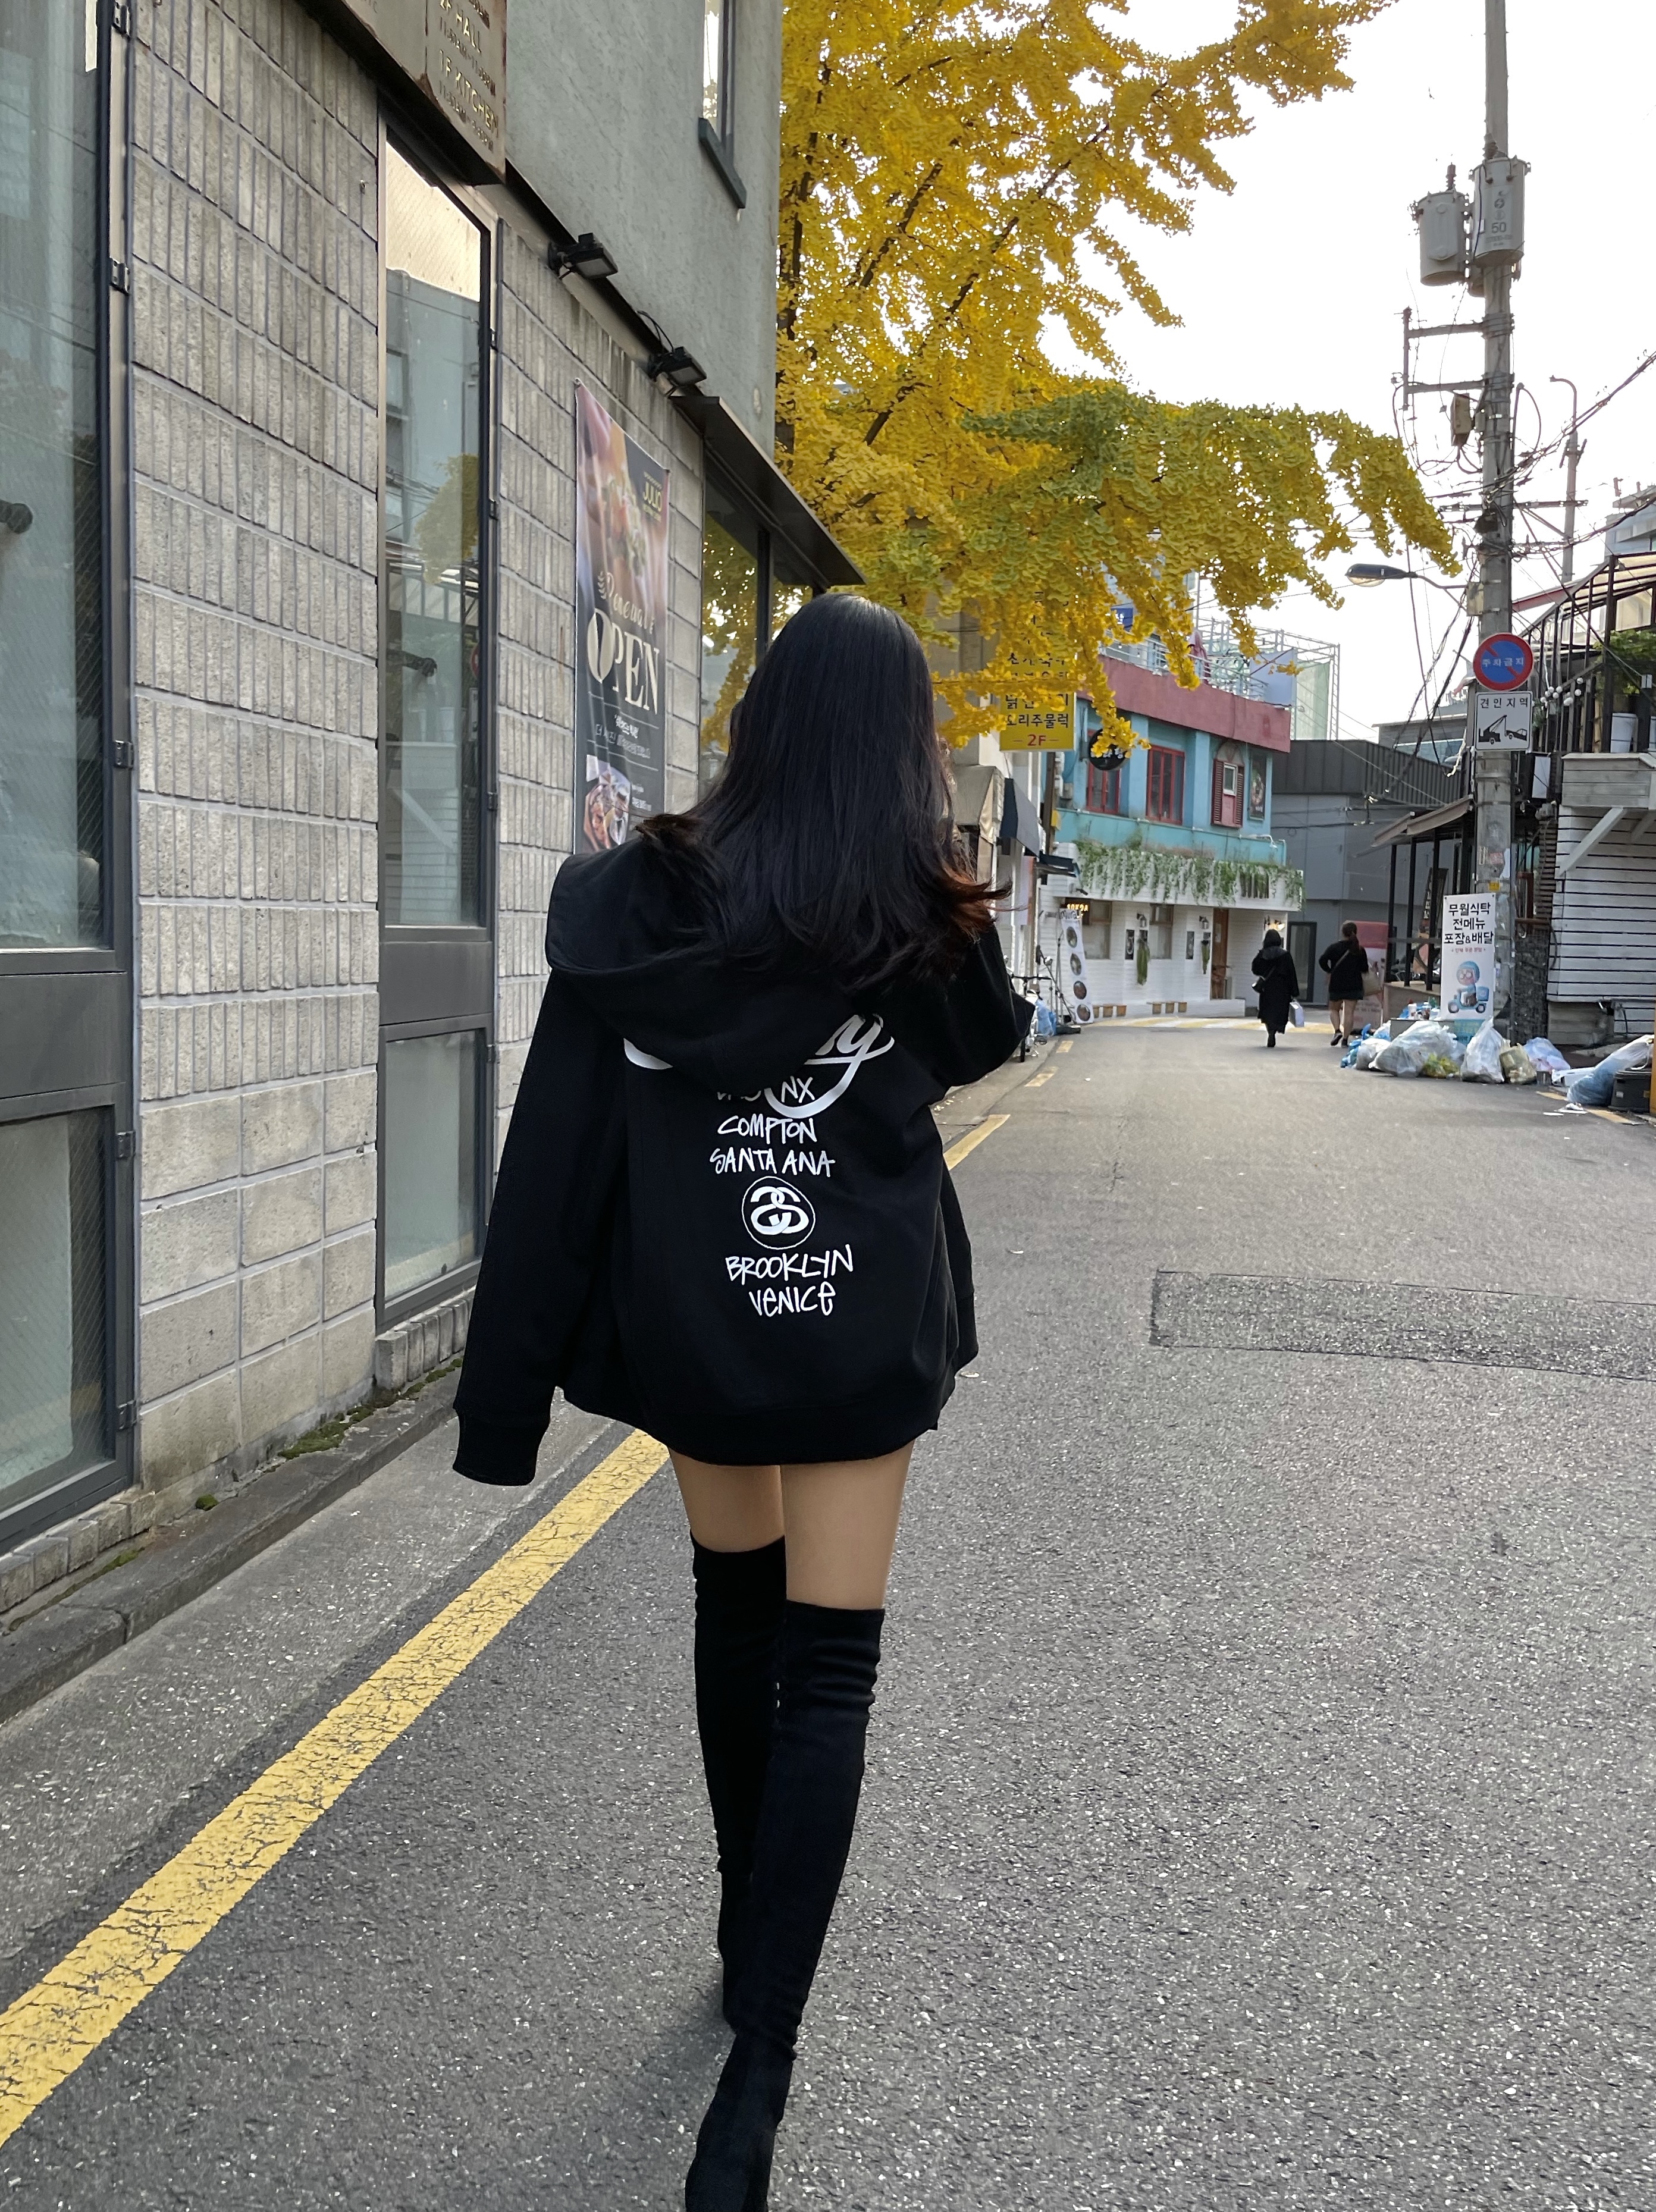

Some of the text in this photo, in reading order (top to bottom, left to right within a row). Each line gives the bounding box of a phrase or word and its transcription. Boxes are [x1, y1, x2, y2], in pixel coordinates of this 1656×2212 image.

[440, 49, 498, 138] 1F KITCHEN
[1492, 222, 1506, 233] 50
[586, 607, 660, 714] OPEN
[1481, 697, 1528, 709] 견인지역
[1007, 713, 1068, 729] 오리주물럭
[1027, 734, 1046, 746] 2F
[1448, 902, 1491, 917] 무월식탁
[1453, 917, 1486, 930] 전메뉴
[1444, 931, 1494, 945] 포장&배달
[717, 1113, 817, 1145] COMPTON
[710, 1146, 836, 1178] SANTA ANA
[725, 1244, 854, 1285] BROOKLYN
